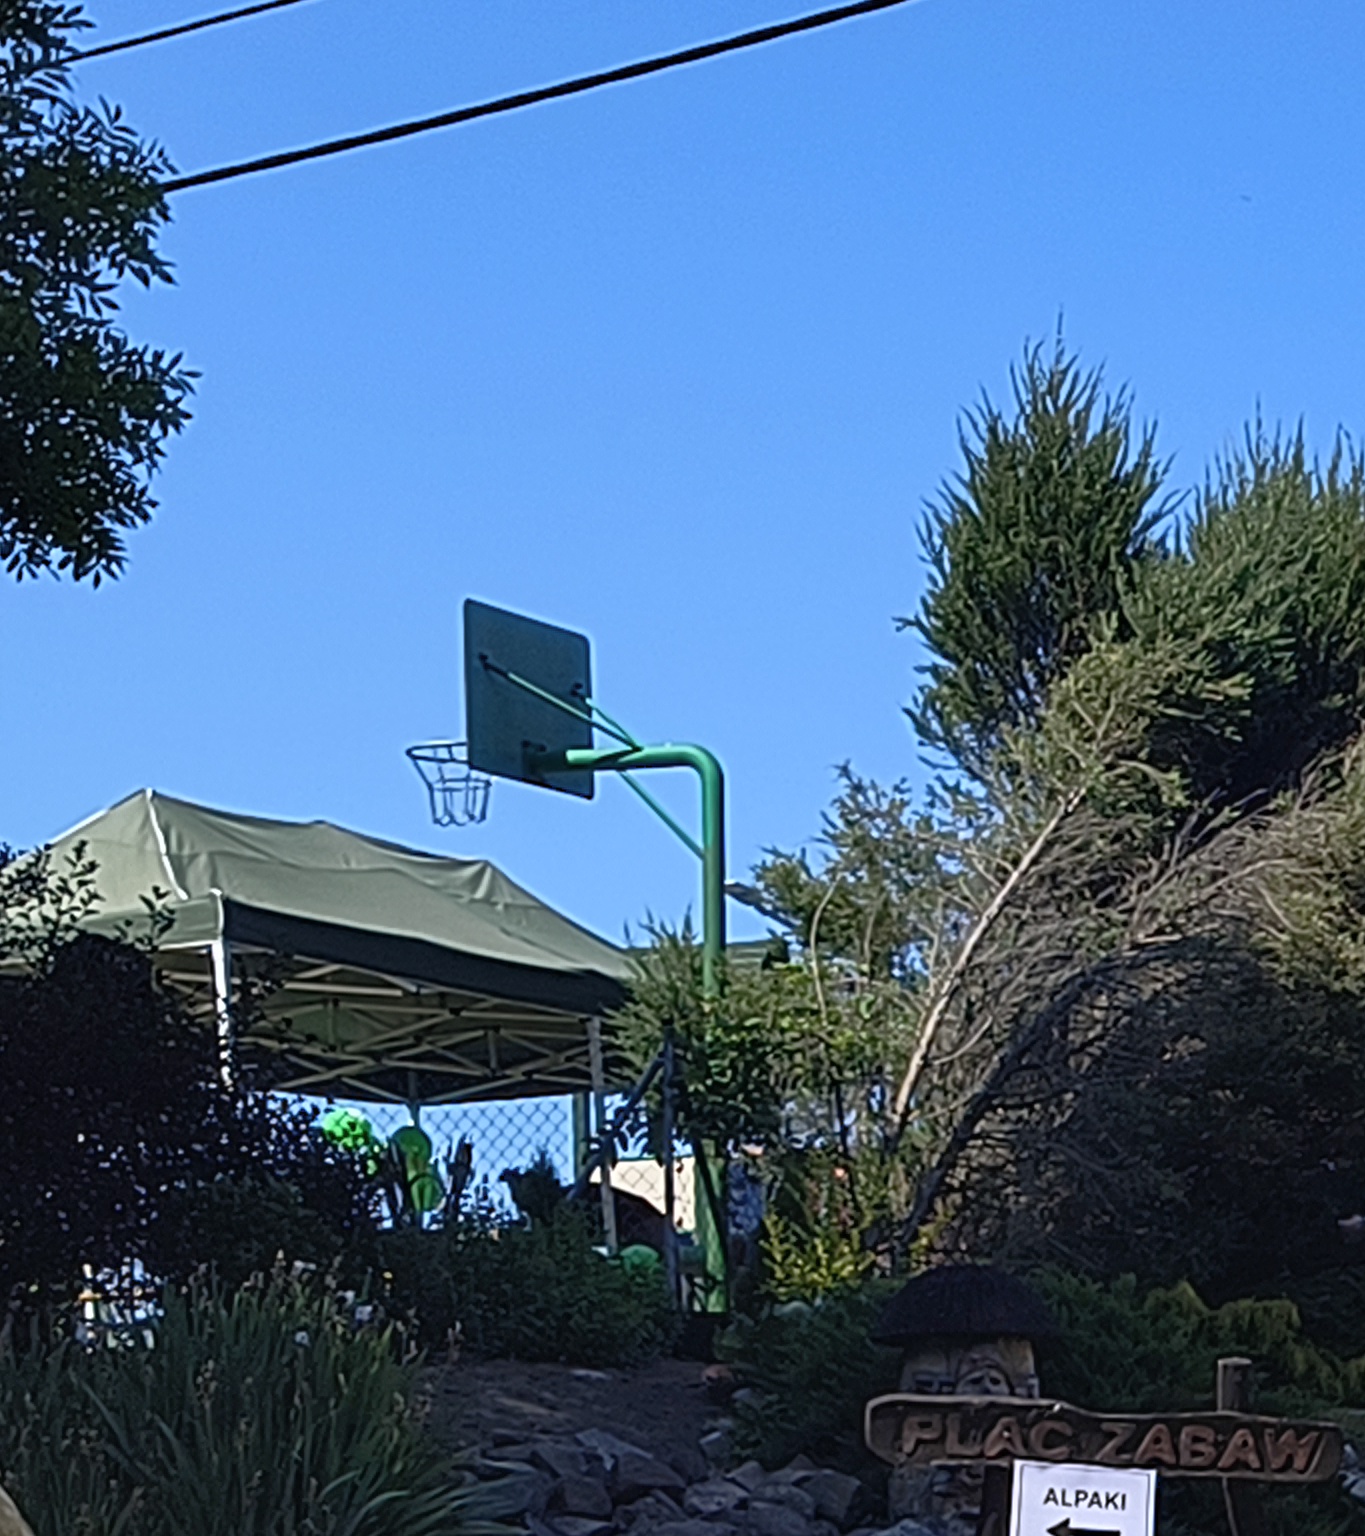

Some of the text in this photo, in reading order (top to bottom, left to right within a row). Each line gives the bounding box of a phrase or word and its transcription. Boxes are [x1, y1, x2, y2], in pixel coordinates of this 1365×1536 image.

[901, 1413, 1320, 1471] PLAC ZABAW
[1042, 1487, 1127, 1511] ALPAKI
